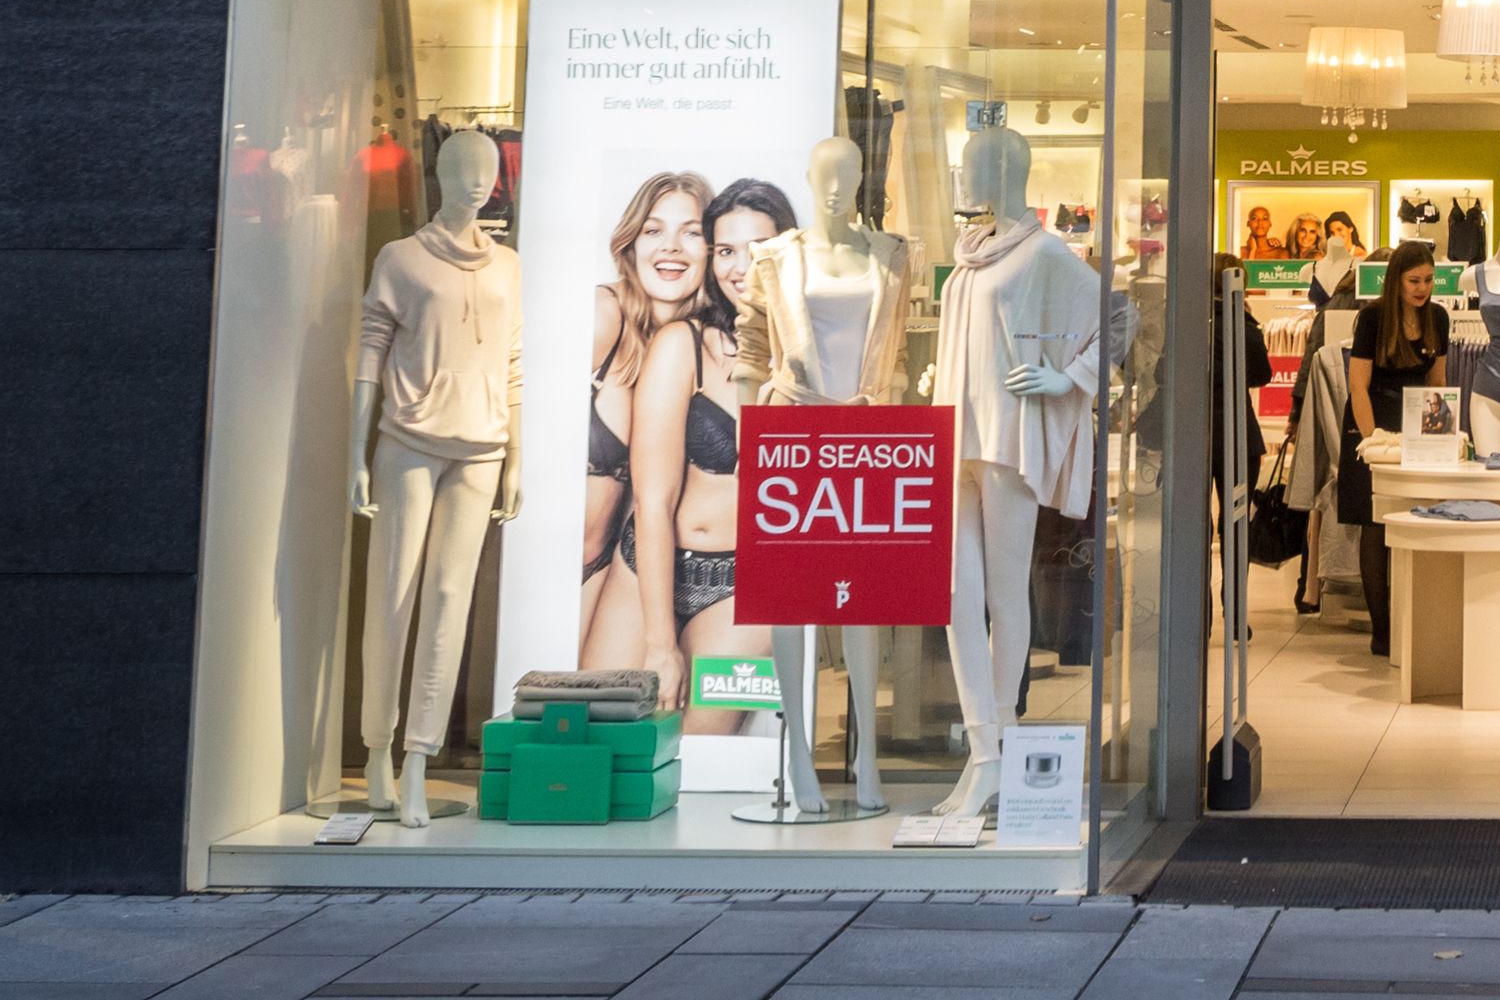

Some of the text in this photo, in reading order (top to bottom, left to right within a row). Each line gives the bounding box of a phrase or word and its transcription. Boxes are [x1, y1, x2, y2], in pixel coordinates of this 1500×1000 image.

[567, 26, 772, 52] Eine Welt, die sich
[566, 55, 782, 85] immer gut anfühlt.
[602, 96, 737, 112] Eine Welt, die passt.
[1240, 159, 1369, 176] PALMERS
[1258, 271, 1300, 281] PALMERS
[757, 443, 935, 470] MID SEASON
[754, 475, 935, 535] SALE
